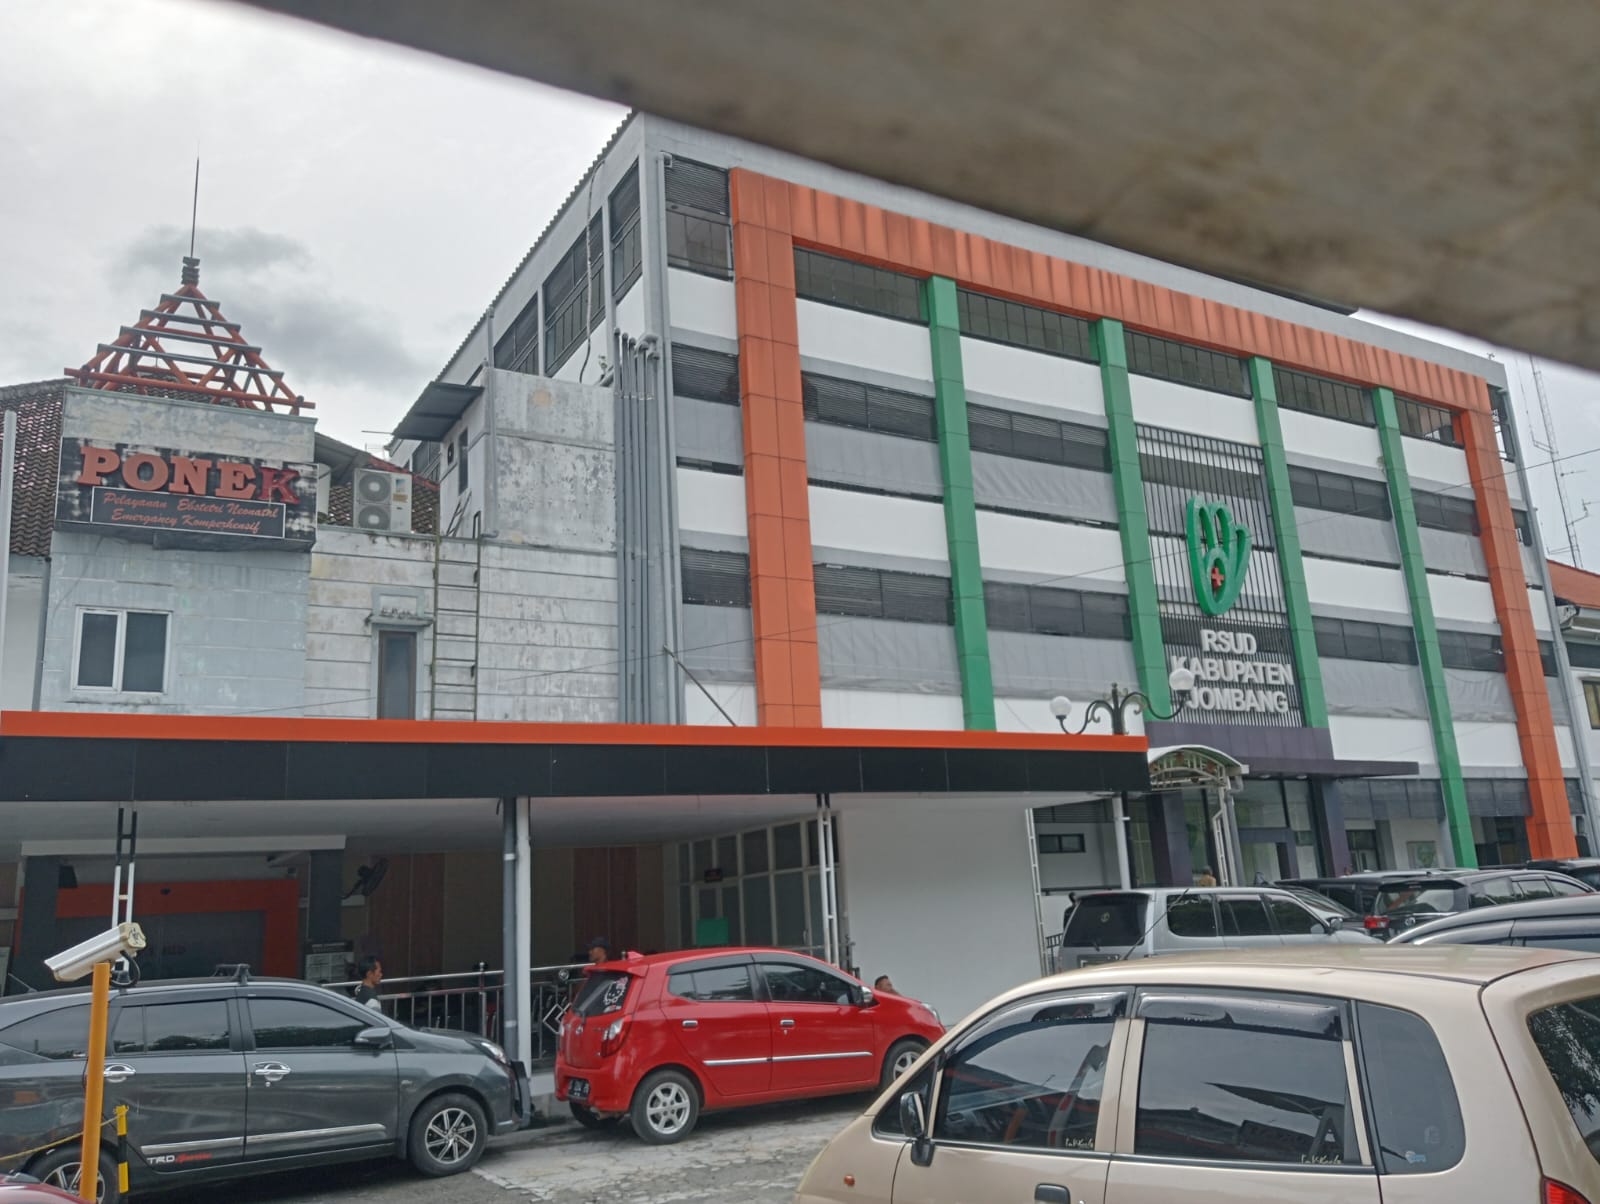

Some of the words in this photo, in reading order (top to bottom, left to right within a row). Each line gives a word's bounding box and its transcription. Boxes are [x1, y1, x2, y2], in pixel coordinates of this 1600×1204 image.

[77, 446, 300, 504] PONEK
[103, 492, 168, 510] Pelayanan
[1200, 629, 1257, 655] RSUD
[1170, 655, 1295, 686] KABUPATEN
[1186, 686, 1289, 713] JOMBANG
[147, 1154, 175, 1165] TRD
